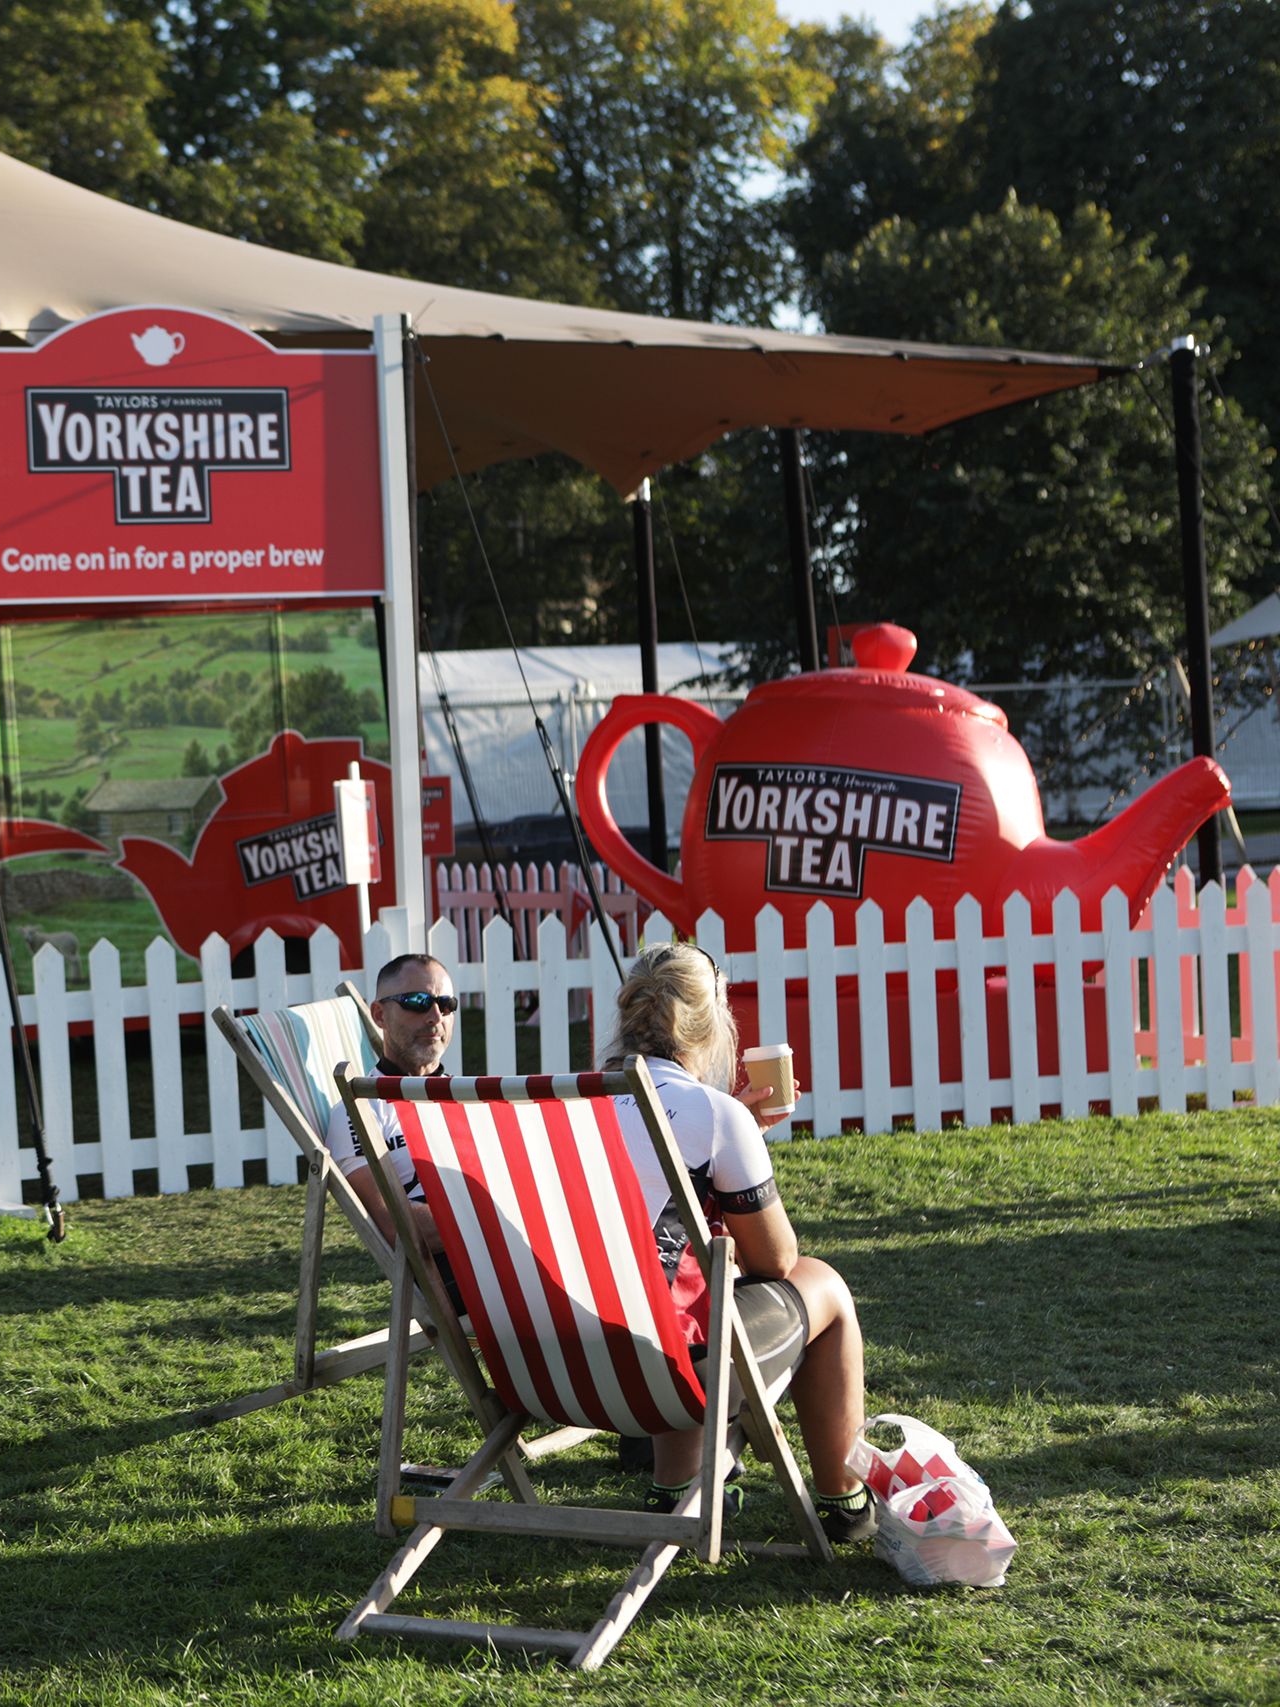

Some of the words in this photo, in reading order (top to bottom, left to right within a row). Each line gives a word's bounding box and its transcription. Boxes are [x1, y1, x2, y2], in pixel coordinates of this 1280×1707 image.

[95, 395, 158, 408] TAYLORS
[37, 403, 279, 461] YORKSHIRE
[122, 467, 202, 513] TEA
[1, 548, 71, 572] Come
[76, 552, 104, 570] on
[109, 547, 130, 569] in
[134, 545, 167, 569] for
[172, 551, 185, 568] a
[190, 548, 264, 574] proper
[269, 544, 324, 567] brew
[757, 769, 826, 784] TAYLORS
[717, 777, 947, 849] YORKSHIRE
[242, 826, 339, 879] YORKSH
[776, 837, 853, 886] TEA
[295, 858, 341, 895] TEA
